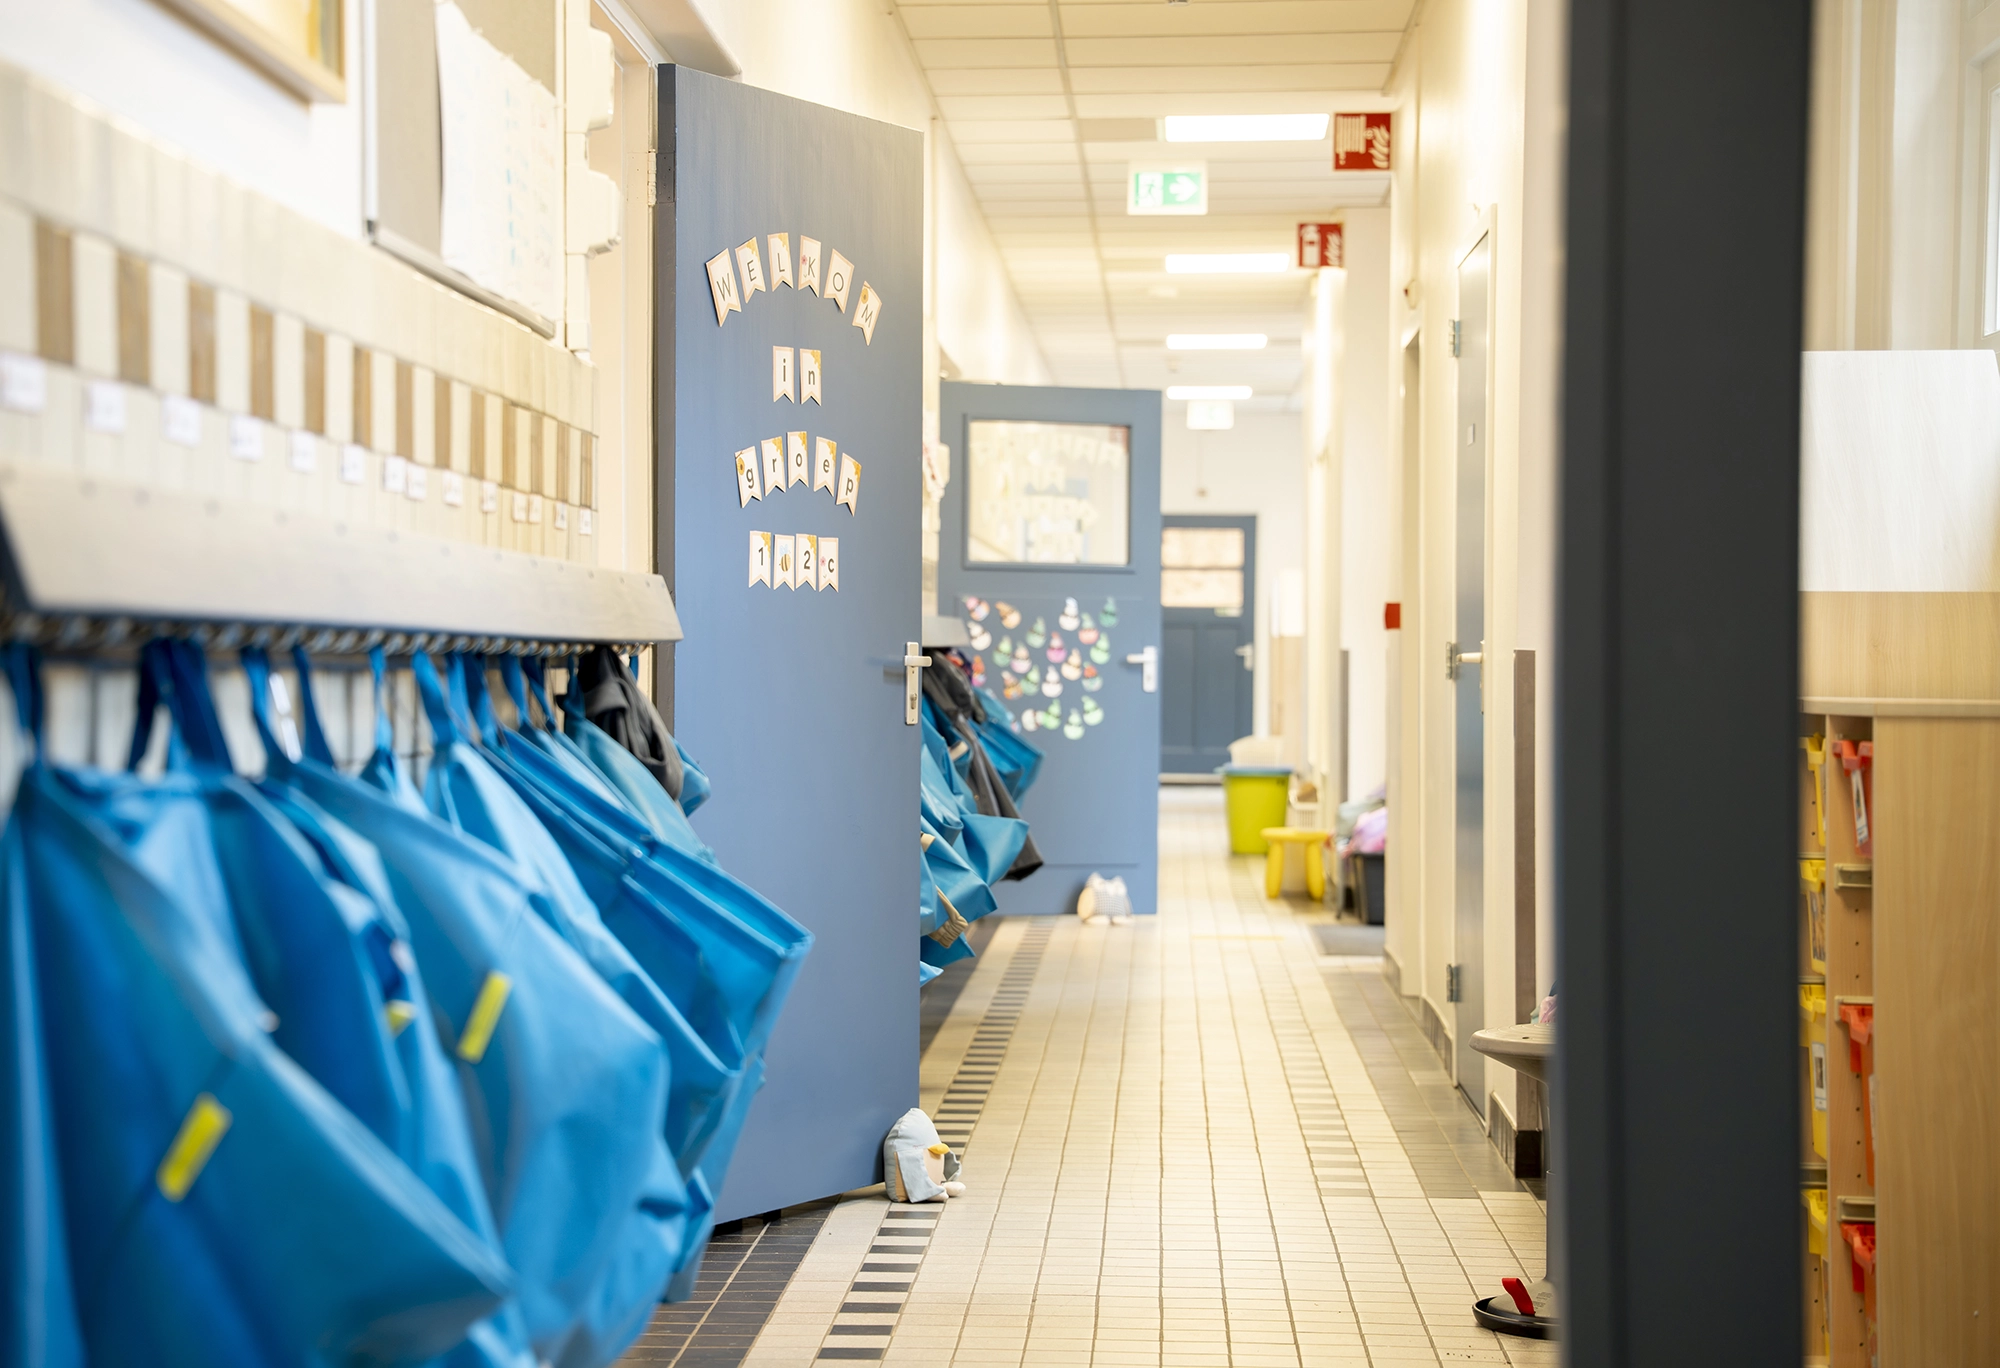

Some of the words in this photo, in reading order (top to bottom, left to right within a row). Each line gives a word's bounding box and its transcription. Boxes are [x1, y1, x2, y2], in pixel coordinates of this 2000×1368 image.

[716, 252, 873, 328] WELKOM
[782, 358, 816, 386] in
[745, 452, 854, 496] groep
